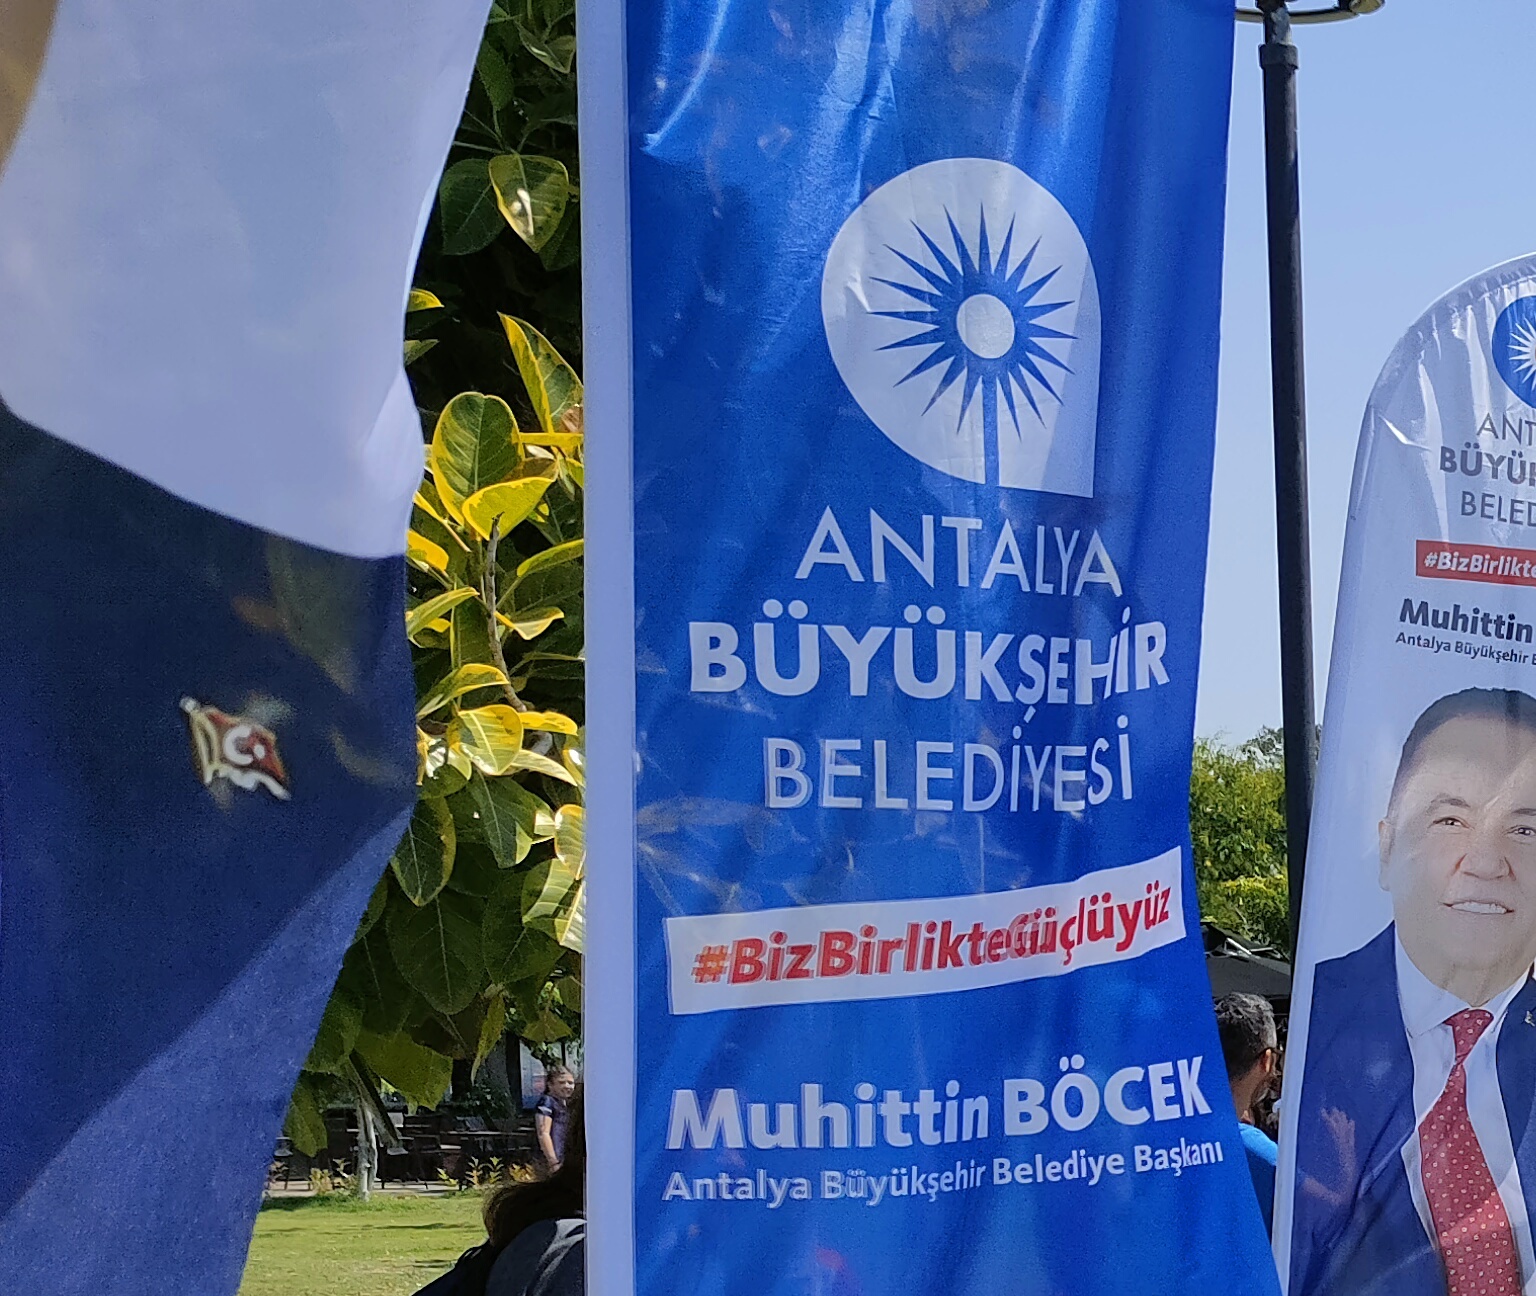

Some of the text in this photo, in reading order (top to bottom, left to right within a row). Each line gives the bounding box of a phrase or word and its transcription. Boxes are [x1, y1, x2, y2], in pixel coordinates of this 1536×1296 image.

[795, 506, 1123, 598] ANTALYA
[688, 598, 1170, 724] BÜYÜKŞEHİR
[1396, 632, 1452, 653] Antalya
[1454, 639, 1530, 667] Büyükşehir
[1399, 598, 1533, 645] Muhittin
[764, 715, 1134, 813] BELEDİYESİ
[692, 882, 1171, 986] #BizBirlikteGüçlüyüz
[666, 1053, 1212, 1152] Muhittin BÖCEK
[664, 1137, 1224, 1210] Antalya Büyükşehir Belediye Başkanı
